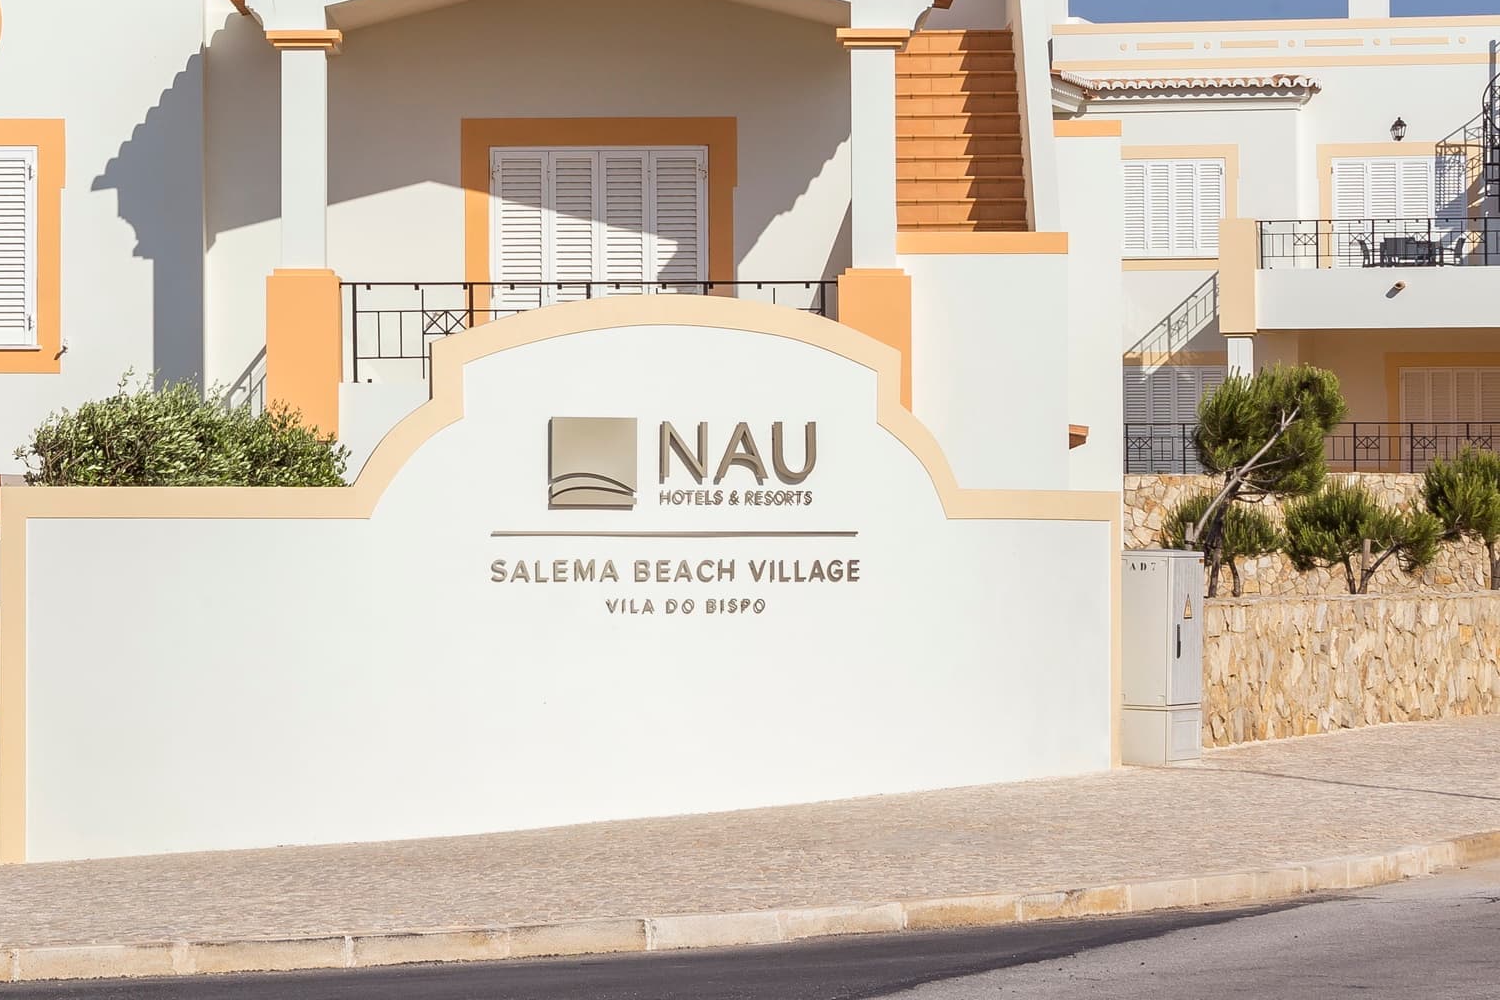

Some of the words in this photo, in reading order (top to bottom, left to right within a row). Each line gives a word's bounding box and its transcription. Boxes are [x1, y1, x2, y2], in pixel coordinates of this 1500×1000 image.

[659, 421, 816, 485] NAU
[659, 490, 723, 506] HOTELS
[728, 490, 739, 506] &
[744, 490, 813, 506] RESORTS
[490, 559, 619, 583] SALEMA
[634, 559, 735, 583] BEACH
[748, 559, 860, 583] VILLAGE
[605, 598, 654, 614] VILA
[665, 598, 695, 614] DO
[705, 598, 766, 614] BISPO
